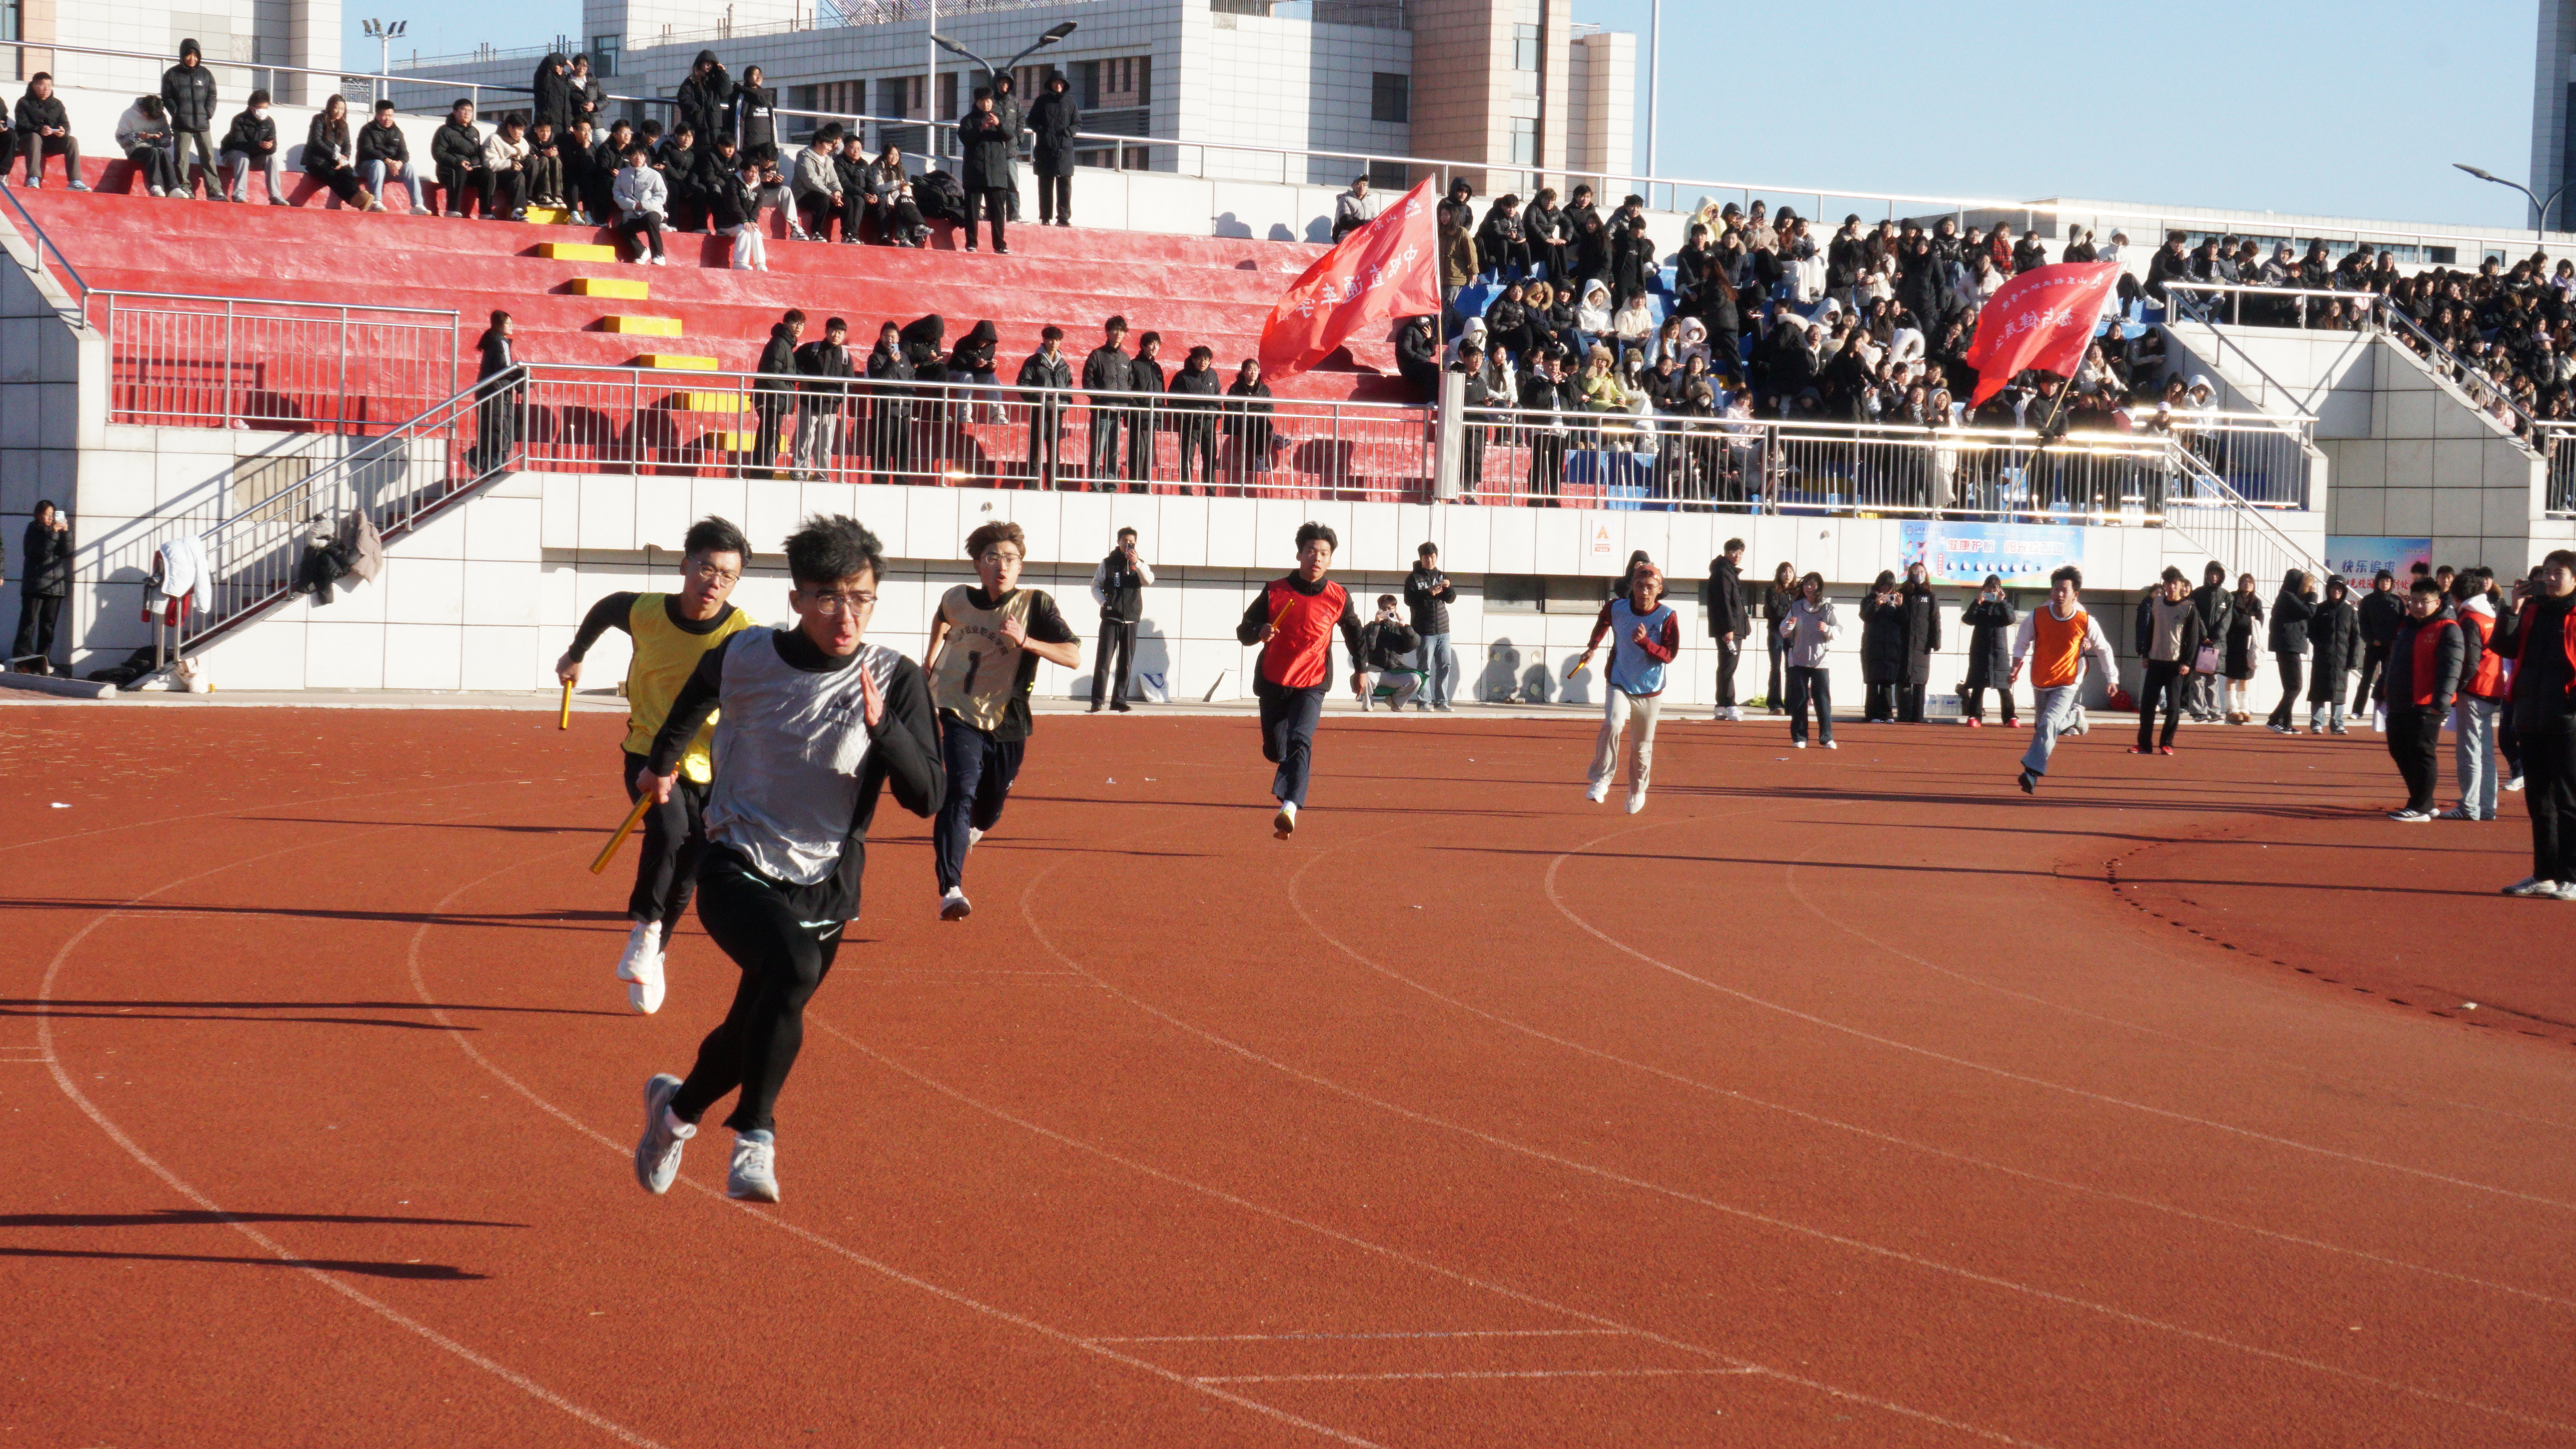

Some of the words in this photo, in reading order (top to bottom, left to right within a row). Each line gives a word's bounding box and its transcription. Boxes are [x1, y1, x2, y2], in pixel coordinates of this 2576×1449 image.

[1948, 539, 1996, 553] 健康护航
[2005, 541, 2064, 554] 阳光校园跑
[2342, 560, 2396, 573] 快乐追求
